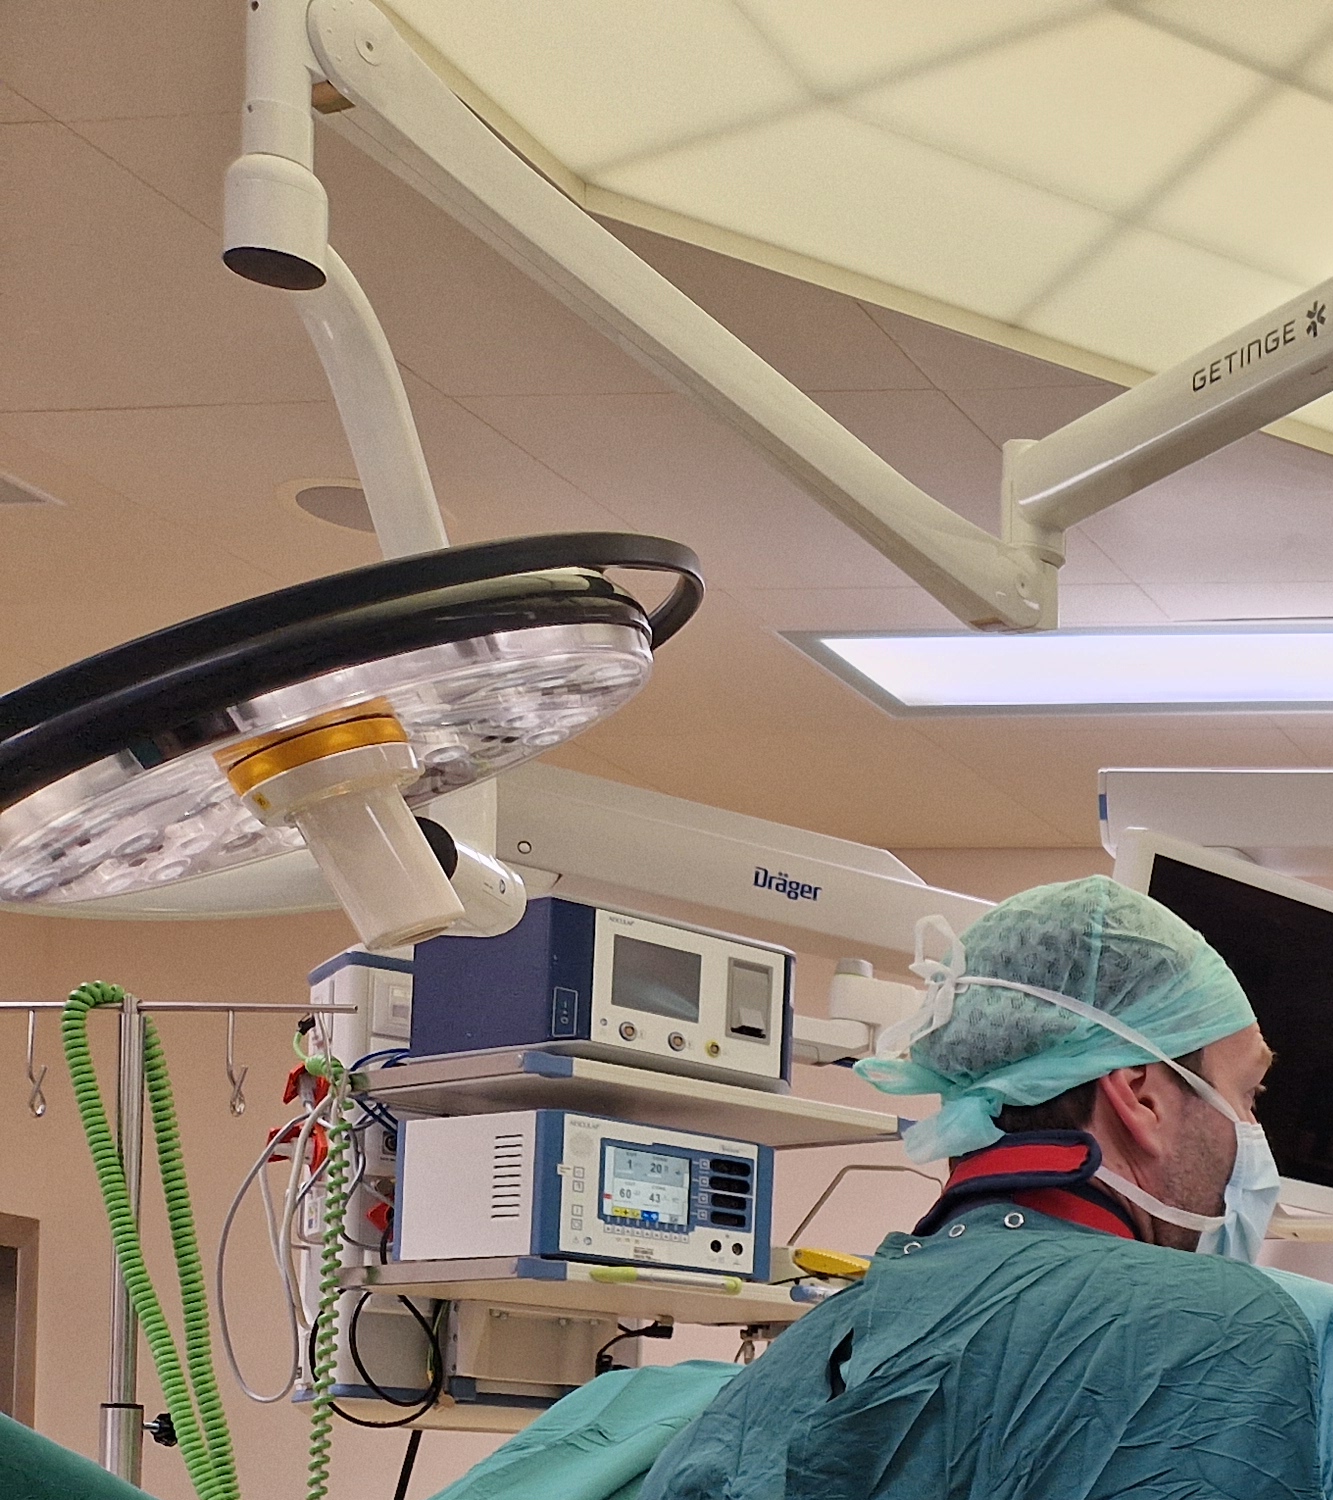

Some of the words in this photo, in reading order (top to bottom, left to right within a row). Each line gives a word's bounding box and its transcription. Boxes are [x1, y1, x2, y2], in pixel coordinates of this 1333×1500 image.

[1192, 319, 1296, 392] GETINGE
[753, 866, 822, 901] Dräger
[650, 1162, 662, 1174] 20
[619, 1188, 632, 1199] 60
[649, 1193, 661, 1204] 43
